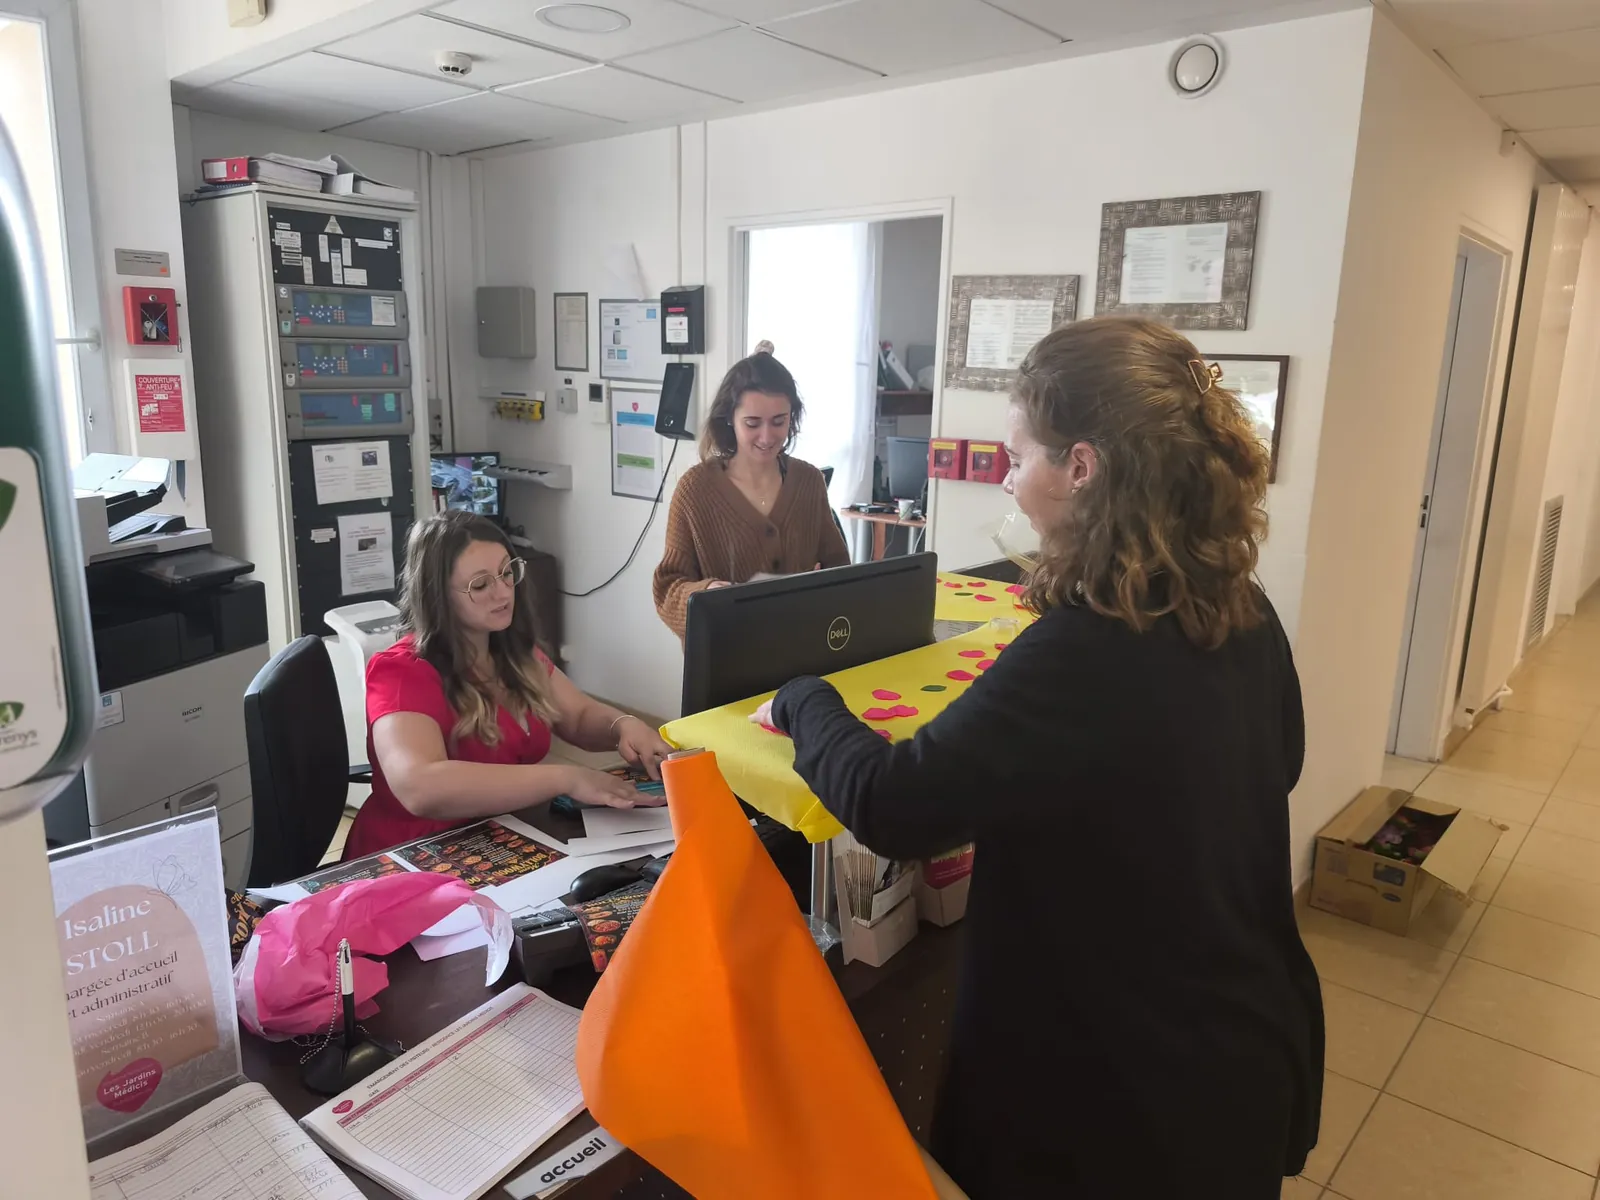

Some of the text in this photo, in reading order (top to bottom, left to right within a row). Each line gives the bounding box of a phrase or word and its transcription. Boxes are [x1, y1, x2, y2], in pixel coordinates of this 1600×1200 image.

[138, 376, 178, 384] COUVERTURE
[830, 627, 848, 640] DELL
[64, 900, 152, 940] Isaline
[66, 930, 159, 976] STOLL
[65, 950, 179, 1001] argée d'accueil
[81, 970, 174, 1015] administratif
[103, 1068, 157, 1096] Les Jardins
[114, 1080, 148, 1099] Médicis
[540, 1137, 607, 1183] accueil
